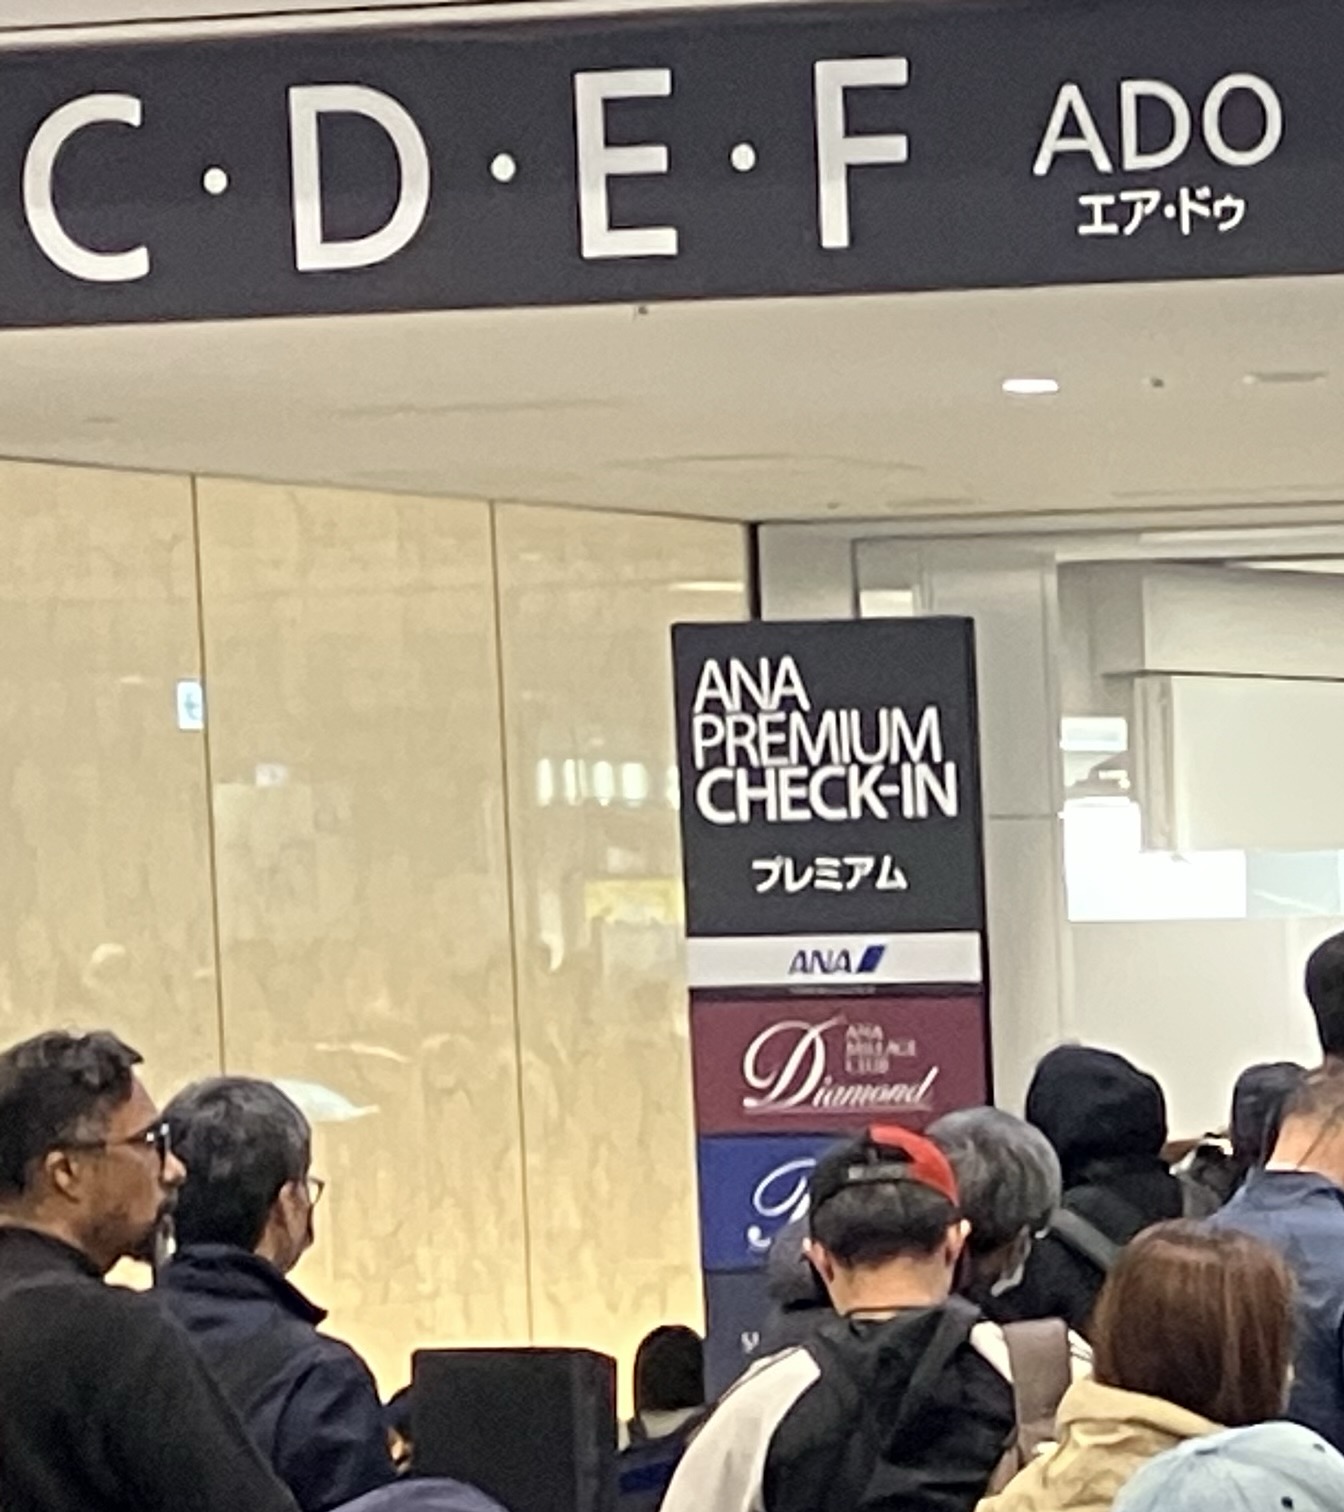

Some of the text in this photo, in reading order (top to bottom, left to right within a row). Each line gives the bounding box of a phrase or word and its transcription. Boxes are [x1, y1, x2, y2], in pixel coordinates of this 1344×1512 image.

[1033, 73, 1282, 176] ADO
[693, 655, 811, 714] ANA
[692, 706, 943, 770] PREMIUM
[695, 761, 958, 824] CHECK-IN
[750, 854, 908, 893] プレミアム
[788, 948, 852, 975] ANA
[742, 1012, 940, 1109] Diamond
